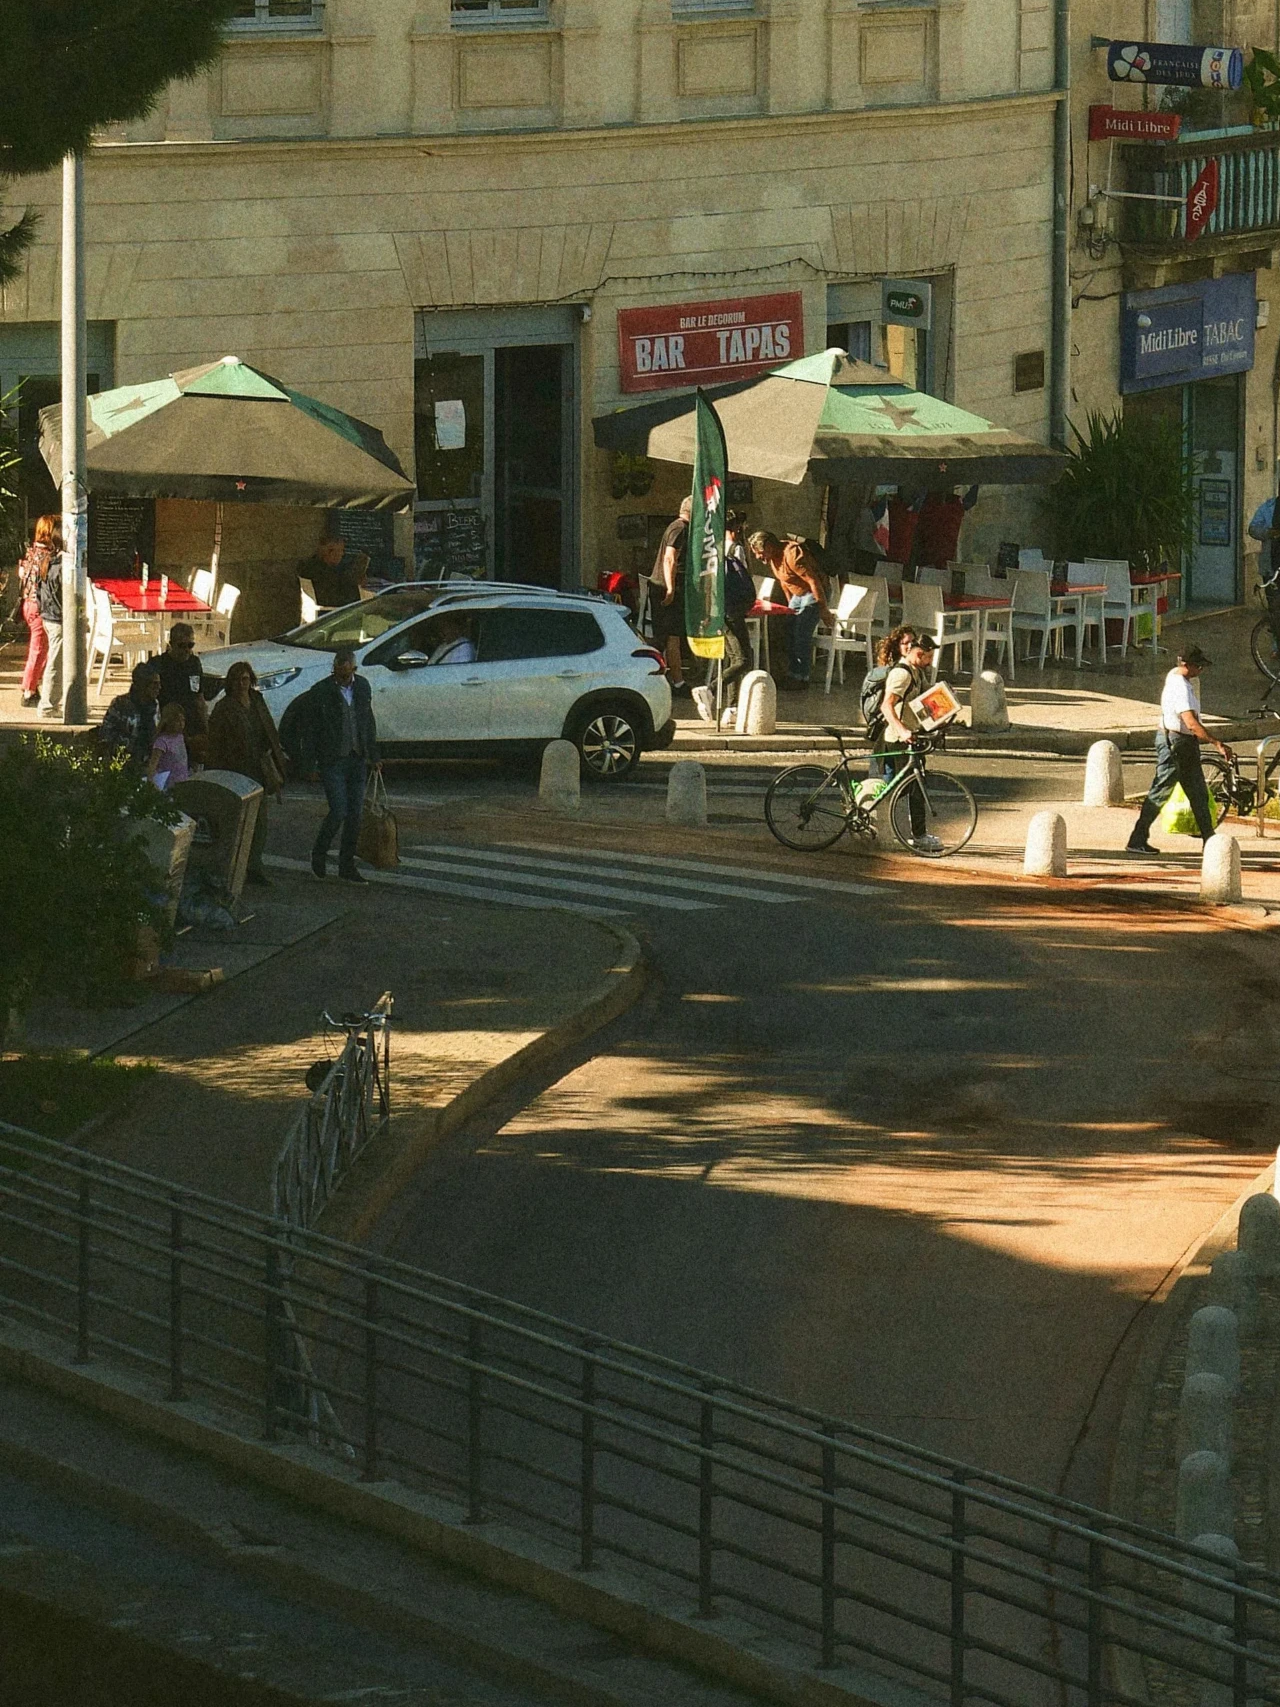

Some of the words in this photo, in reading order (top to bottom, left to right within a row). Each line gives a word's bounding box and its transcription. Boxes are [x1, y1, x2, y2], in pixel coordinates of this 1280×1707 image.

[1105, 118, 1133, 131] Midi
[1137, 120, 1171, 134] Libre
[1192, 181, 1210, 221] TABAC
[890, 299, 908, 309] PMU
[679, 316, 697, 329] BAR
[697, 315, 707, 327] LE
[1204, 318, 1245, 346] TABAC
[635, 335, 686, 373] BAR
[716, 324, 791, 365] TAPAS
[1140, 331, 1167, 354] Midi
[1168, 327, 1198, 349] Libre
